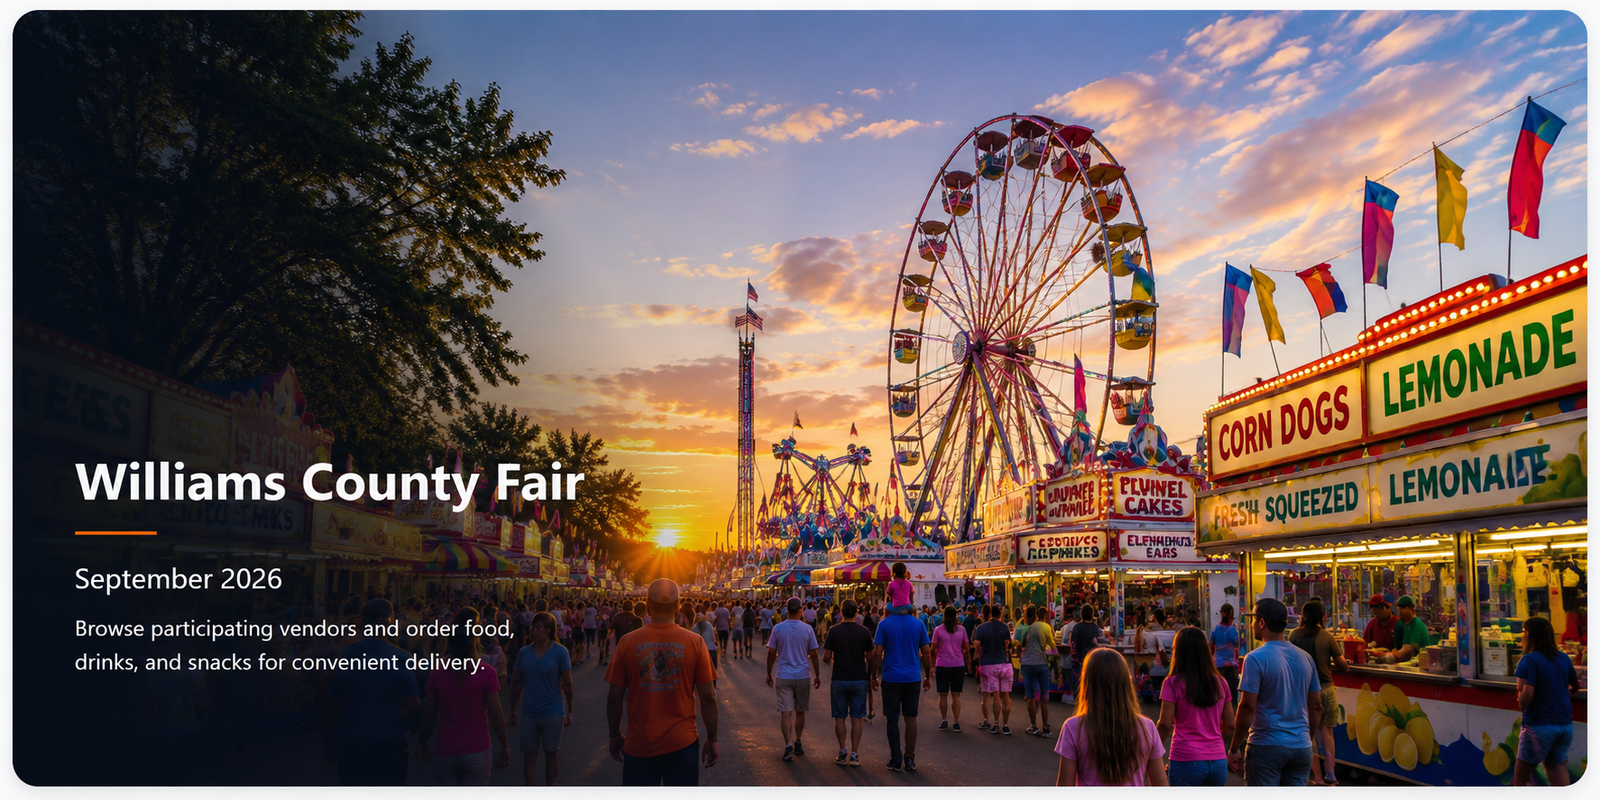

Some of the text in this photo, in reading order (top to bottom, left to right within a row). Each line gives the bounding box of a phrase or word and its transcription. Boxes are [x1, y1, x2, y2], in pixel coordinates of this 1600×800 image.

[1383, 308, 1577, 418] LEMONADE
[1219, 385, 1350, 462] CORN DOGS
[1124, 496, 1184, 516] CAKES
[1265, 481, 1359, 525] SQUEEZED
